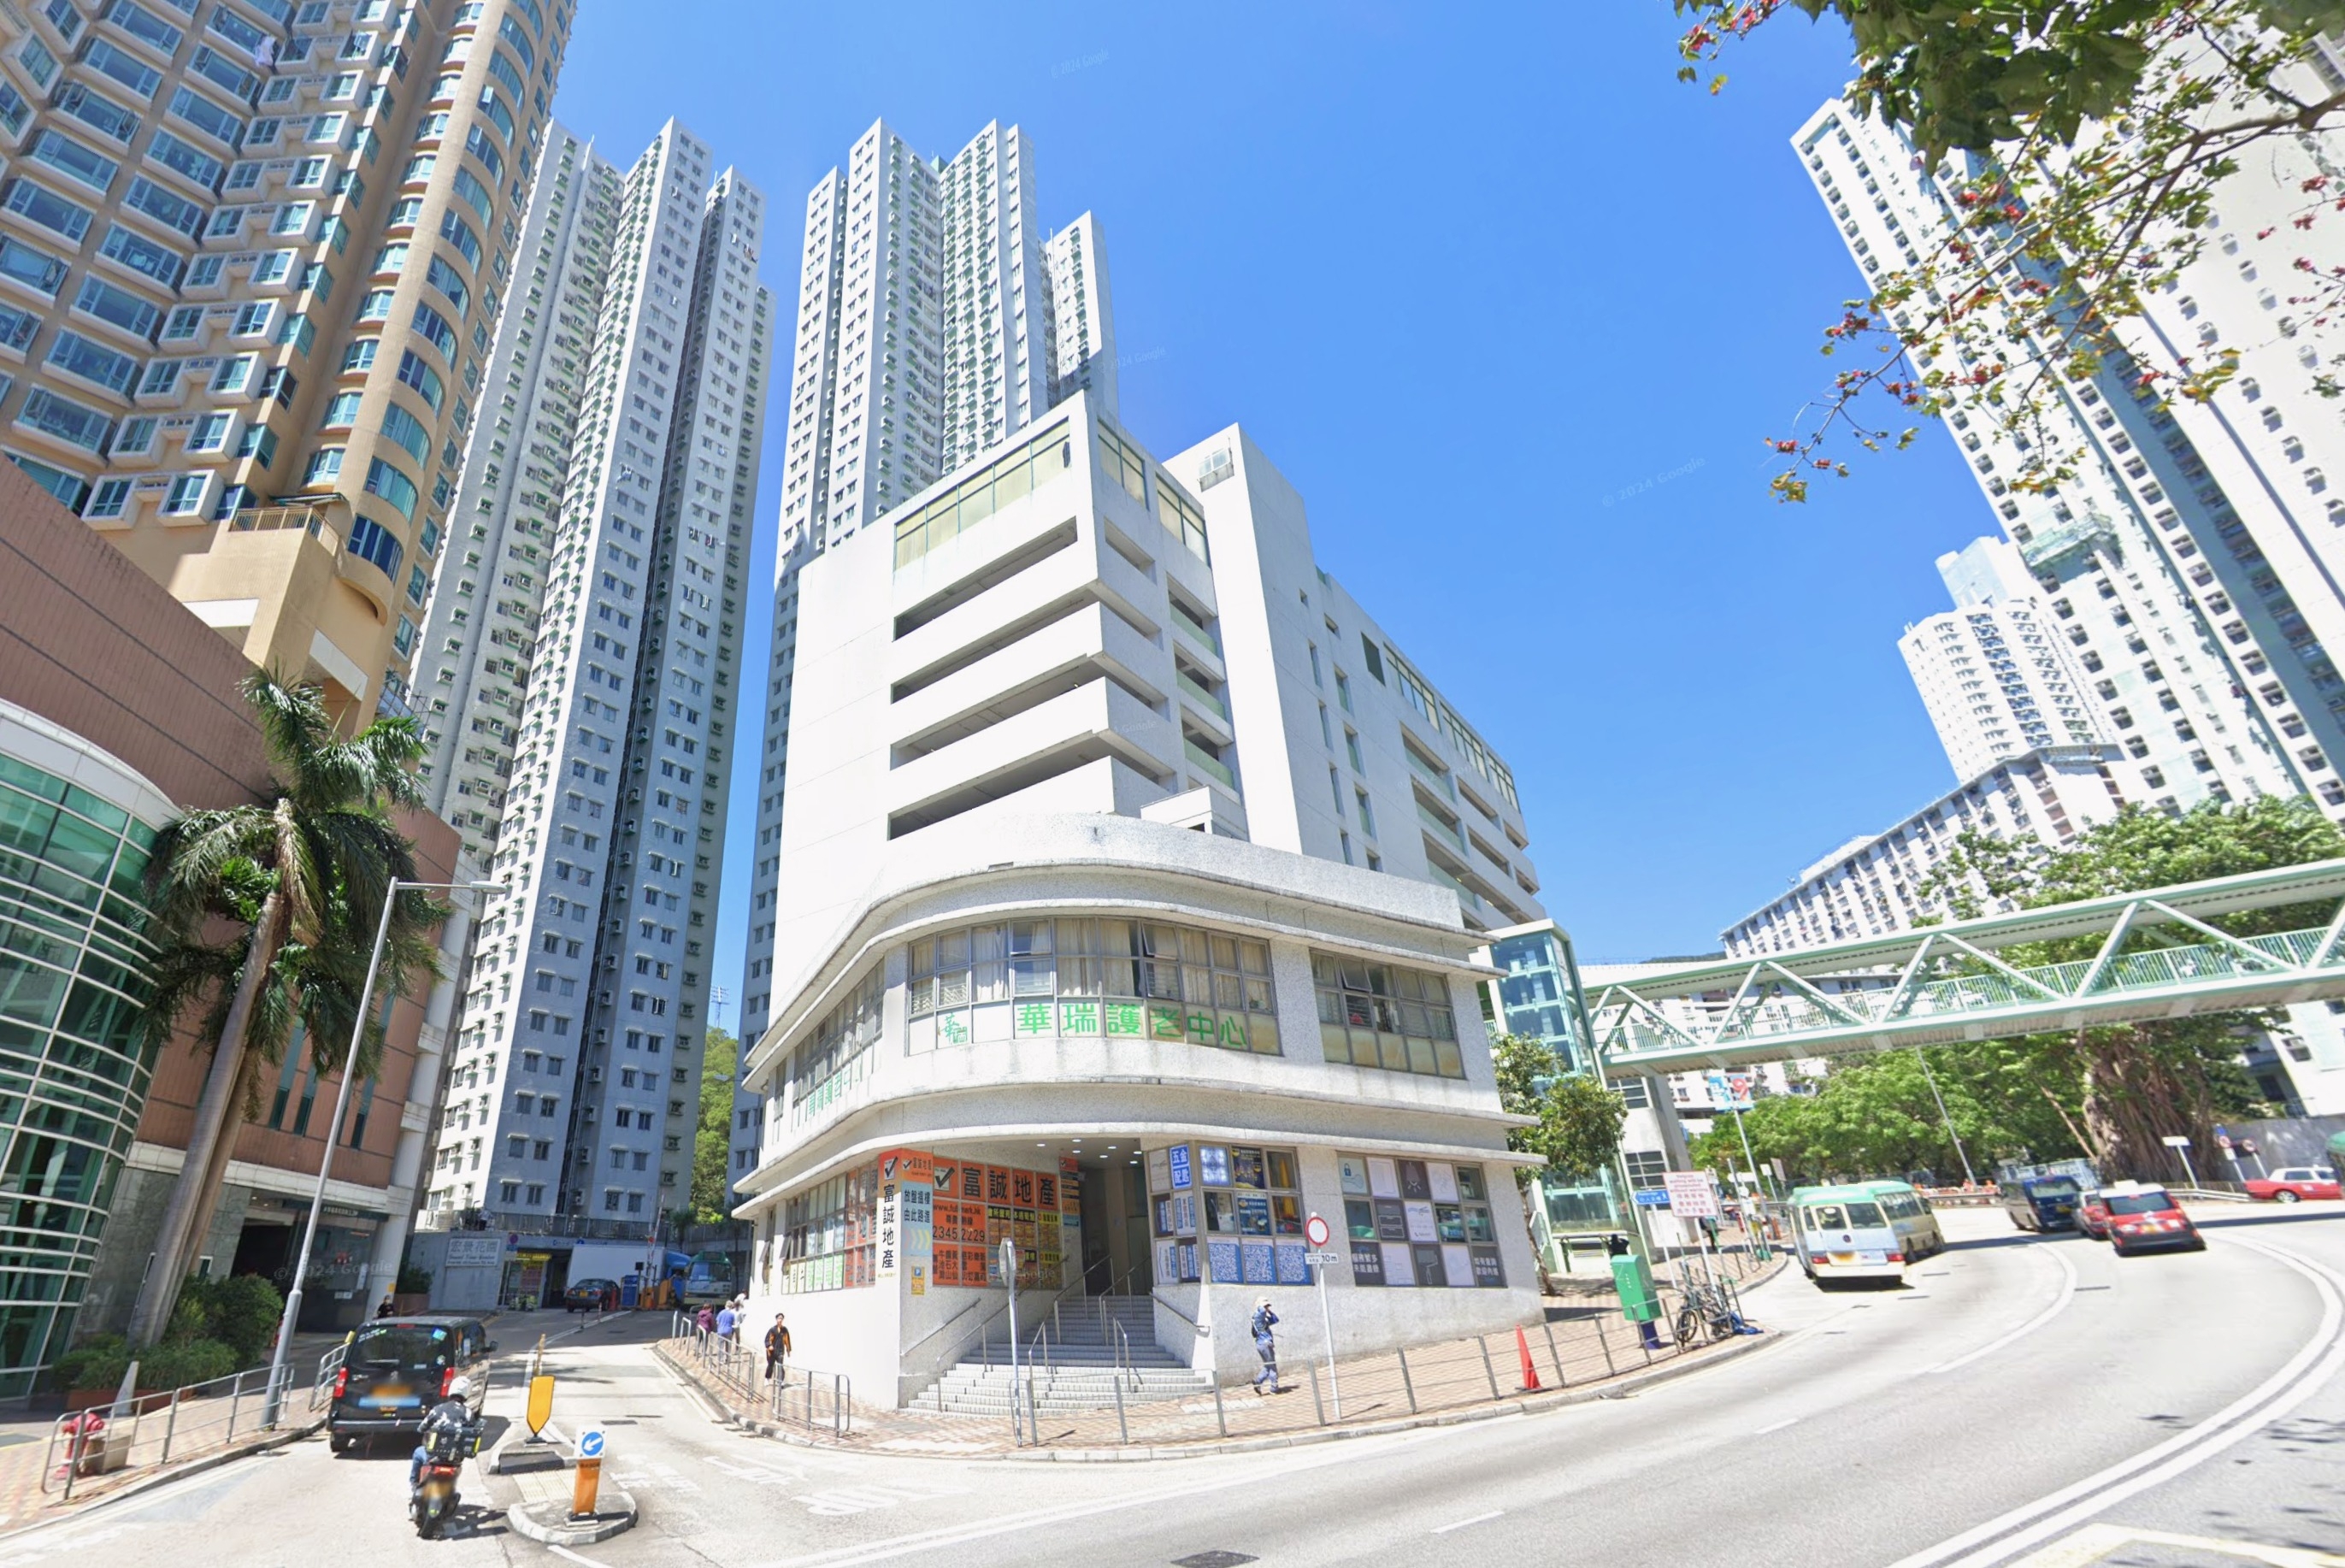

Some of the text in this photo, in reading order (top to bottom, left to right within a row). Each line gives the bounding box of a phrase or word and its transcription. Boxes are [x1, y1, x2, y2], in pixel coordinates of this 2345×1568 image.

[1016, 1002, 1247, 1047] 華瑞護老中心
[1171, 1147, 1188, 1164] 五金
[963, 1166, 1055, 1206] 富誠地產
[1173, 1168, 1190, 1184] 配匙
[881, 1183, 896, 1270] 富誠地產
[932, 1225, 986, 1243] 2345 2229
